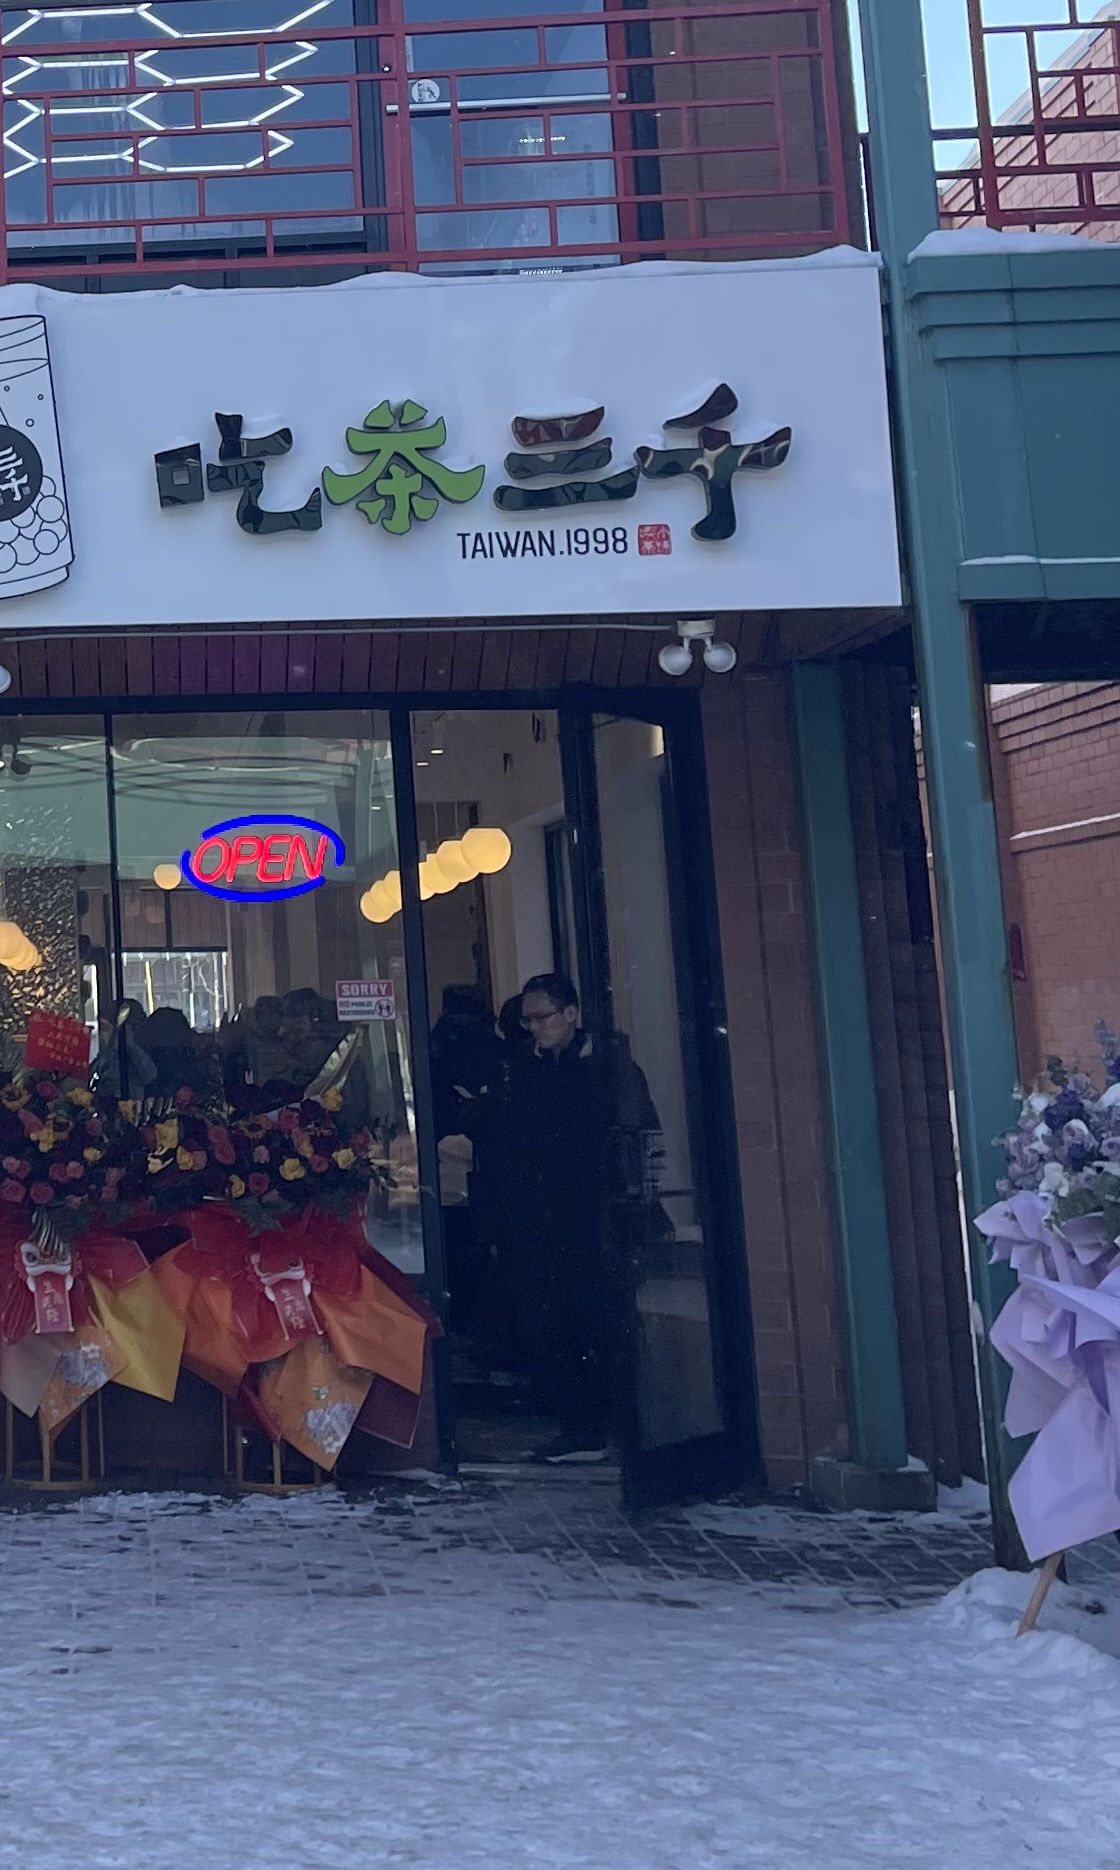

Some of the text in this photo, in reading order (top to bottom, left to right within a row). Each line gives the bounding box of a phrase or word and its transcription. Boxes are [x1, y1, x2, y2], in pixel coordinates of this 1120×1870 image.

[153, 382, 792, 541] 吃茶三千
[191, 833, 329, 883] OPEN
[341, 983, 388, 997] SORRY
